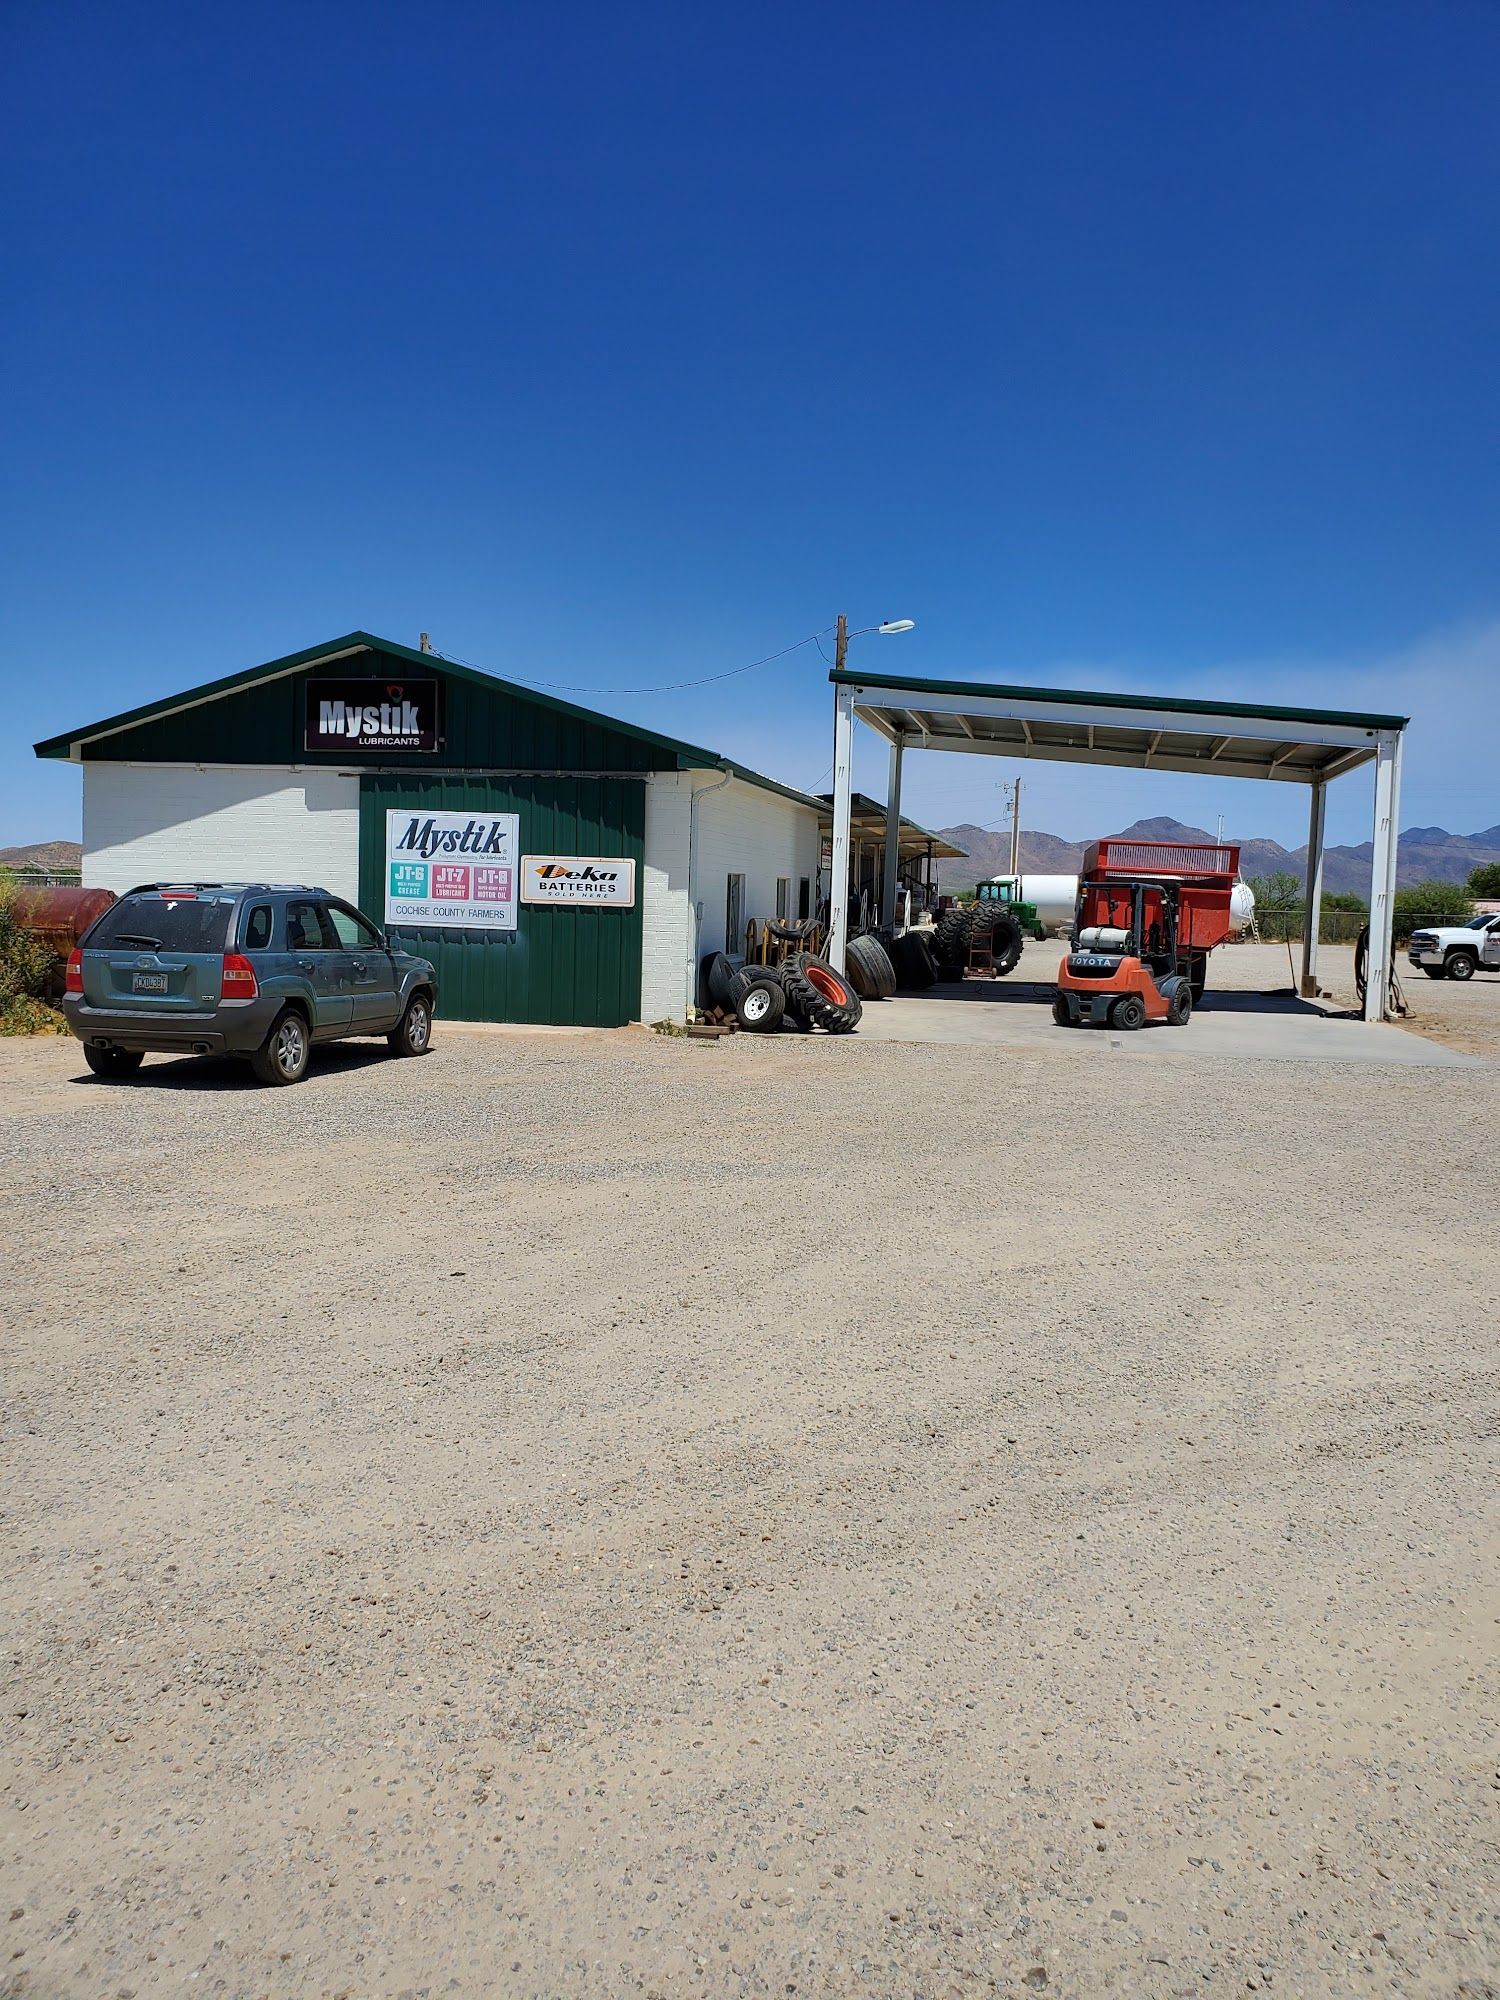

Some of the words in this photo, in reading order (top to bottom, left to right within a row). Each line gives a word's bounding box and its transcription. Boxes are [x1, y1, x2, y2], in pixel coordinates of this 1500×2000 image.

[319, 700, 420, 738] Mystik
[358, 737, 421, 746] LUBRICANTS
[395, 818, 507, 859] Mystik
[394, 865, 425, 881] JT-6
[436, 867, 465, 883] JT-7
[477, 869, 508, 885] JT-8
[535, 864, 618, 882] Deka
[398, 887, 420, 896] GREASE
[435, 889, 466, 897] LUBRICANT
[539, 881, 616, 893] BATTERIES
[478, 891, 496, 899] MOTOR
[497, 892, 507, 900] OIL
[395, 905, 430, 916] COCHISE
[433, 907, 465, 918] COUNTY
[468, 908, 505, 919] FARMERS
[1071, 957, 1112, 967] TOYOTA
